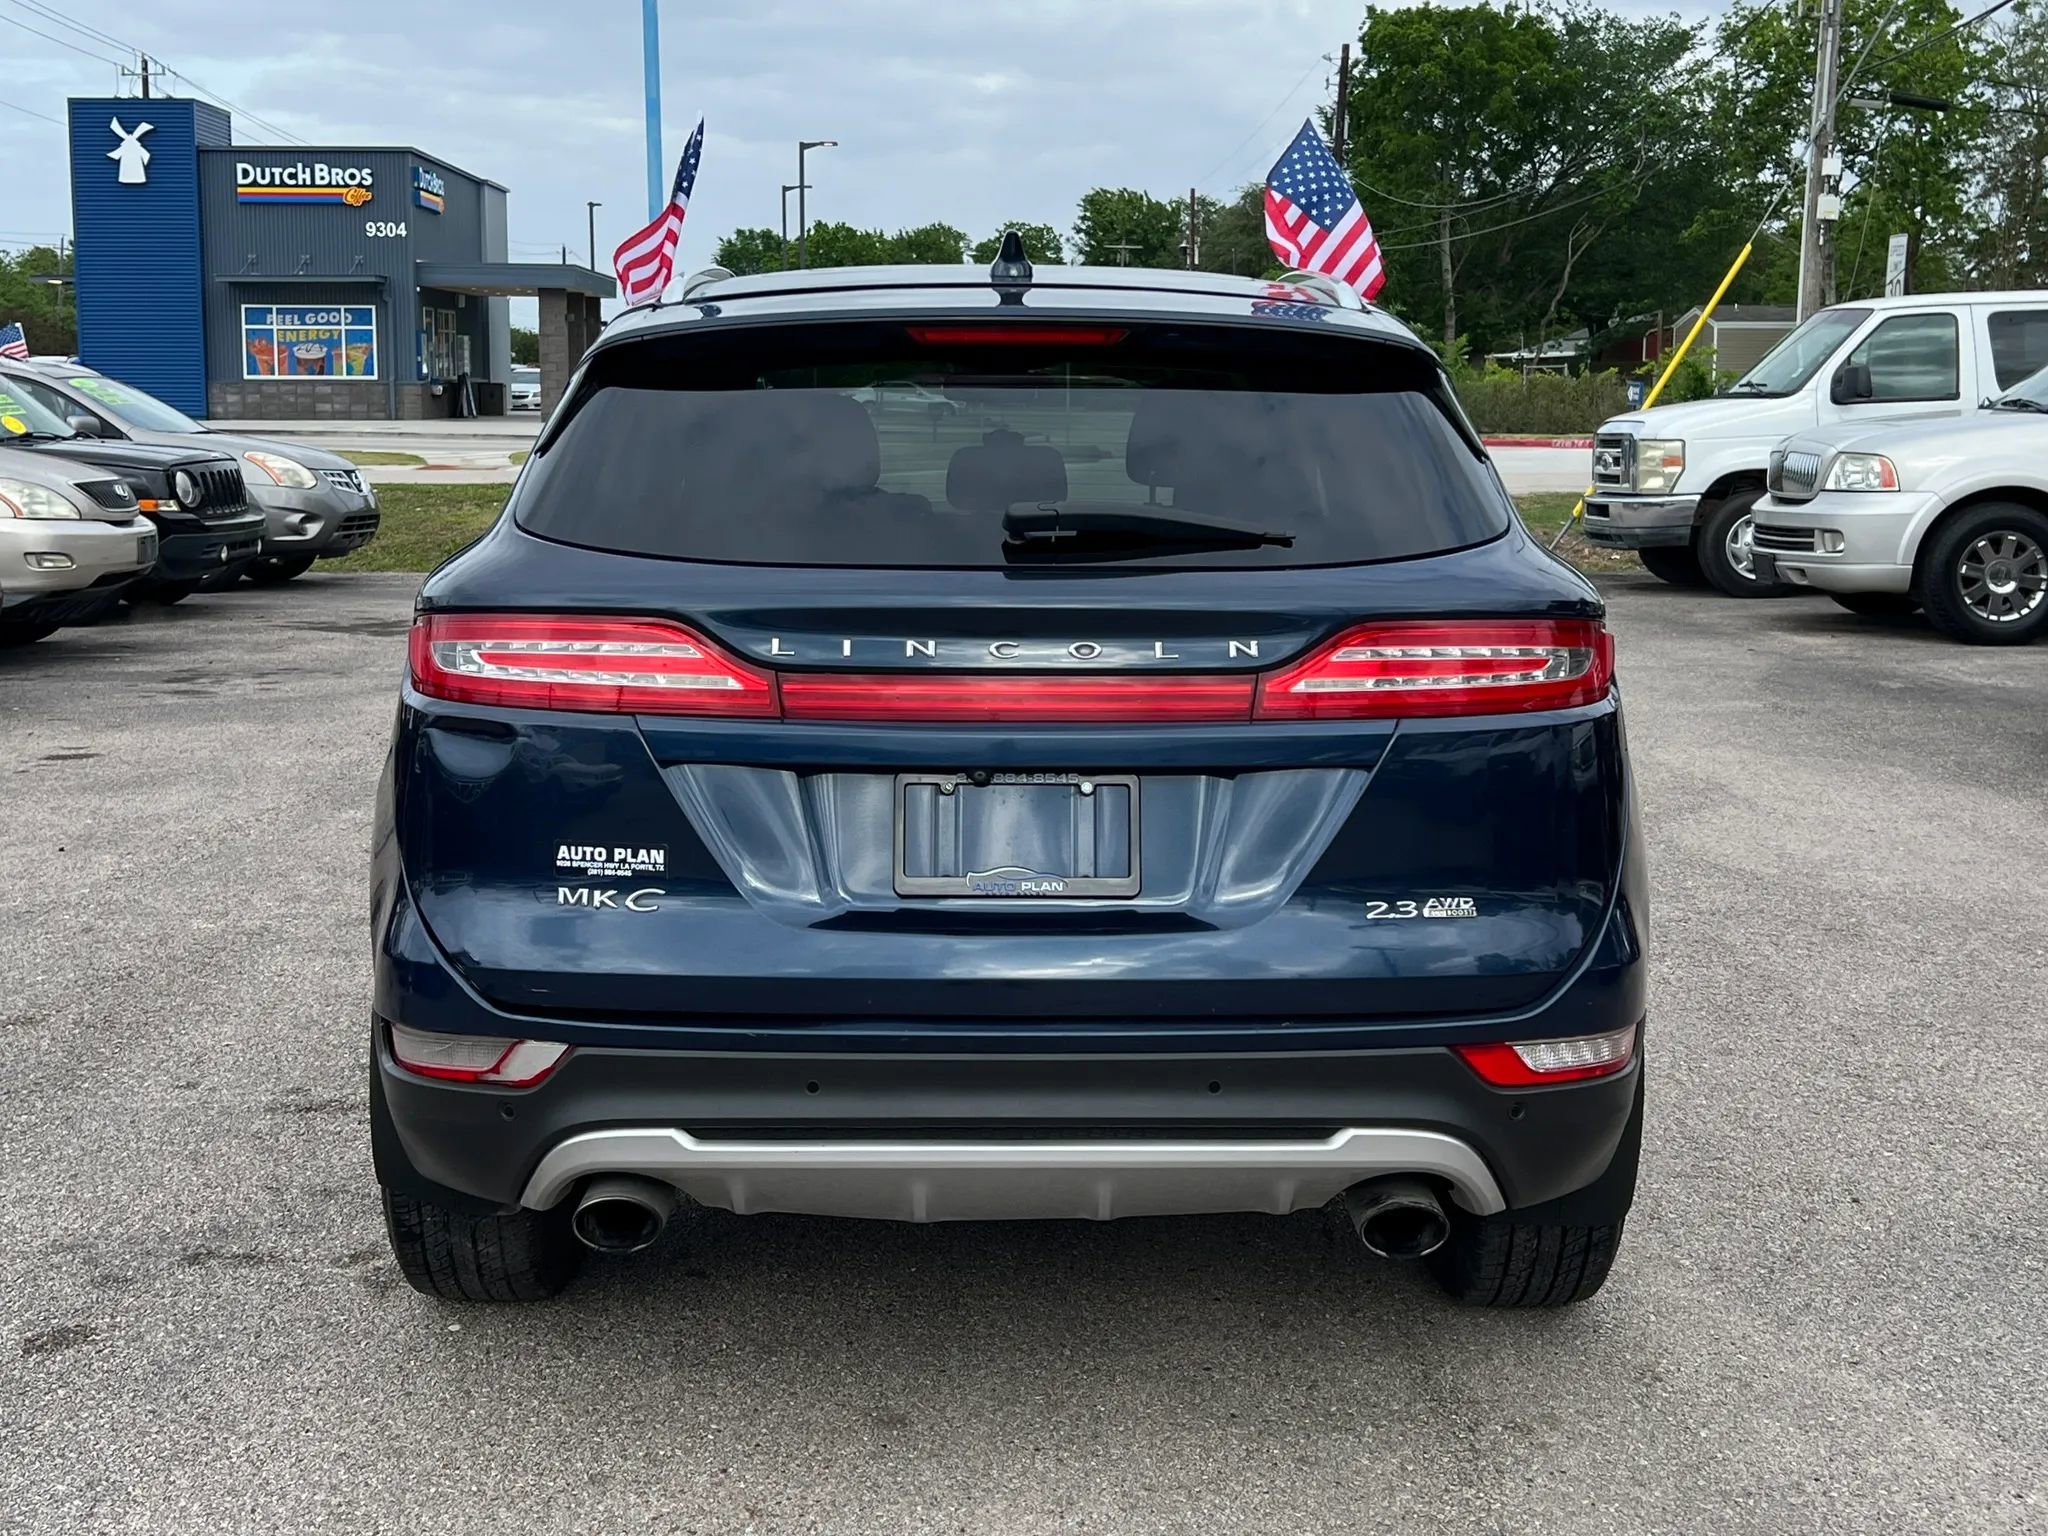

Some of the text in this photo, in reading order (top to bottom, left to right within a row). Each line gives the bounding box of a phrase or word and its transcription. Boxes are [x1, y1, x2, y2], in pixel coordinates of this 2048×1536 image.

[313, 163, 373, 186] BROS
[342, 186, 372, 207] Coffee
[365, 221, 407, 238] 9304
[266, 312, 352, 325] FEEL GOOD
[277, 330, 341, 342] ENERGY
[770, 637, 1260, 660] LINCOLN
[557, 845, 665, 864] AUTO PLAN
[655, 864, 665, 872] TX
[973, 881, 1064, 892] AUTO PLAN
[557, 887, 666, 911] MKC
[1424, 897, 1474, 909] AWD
